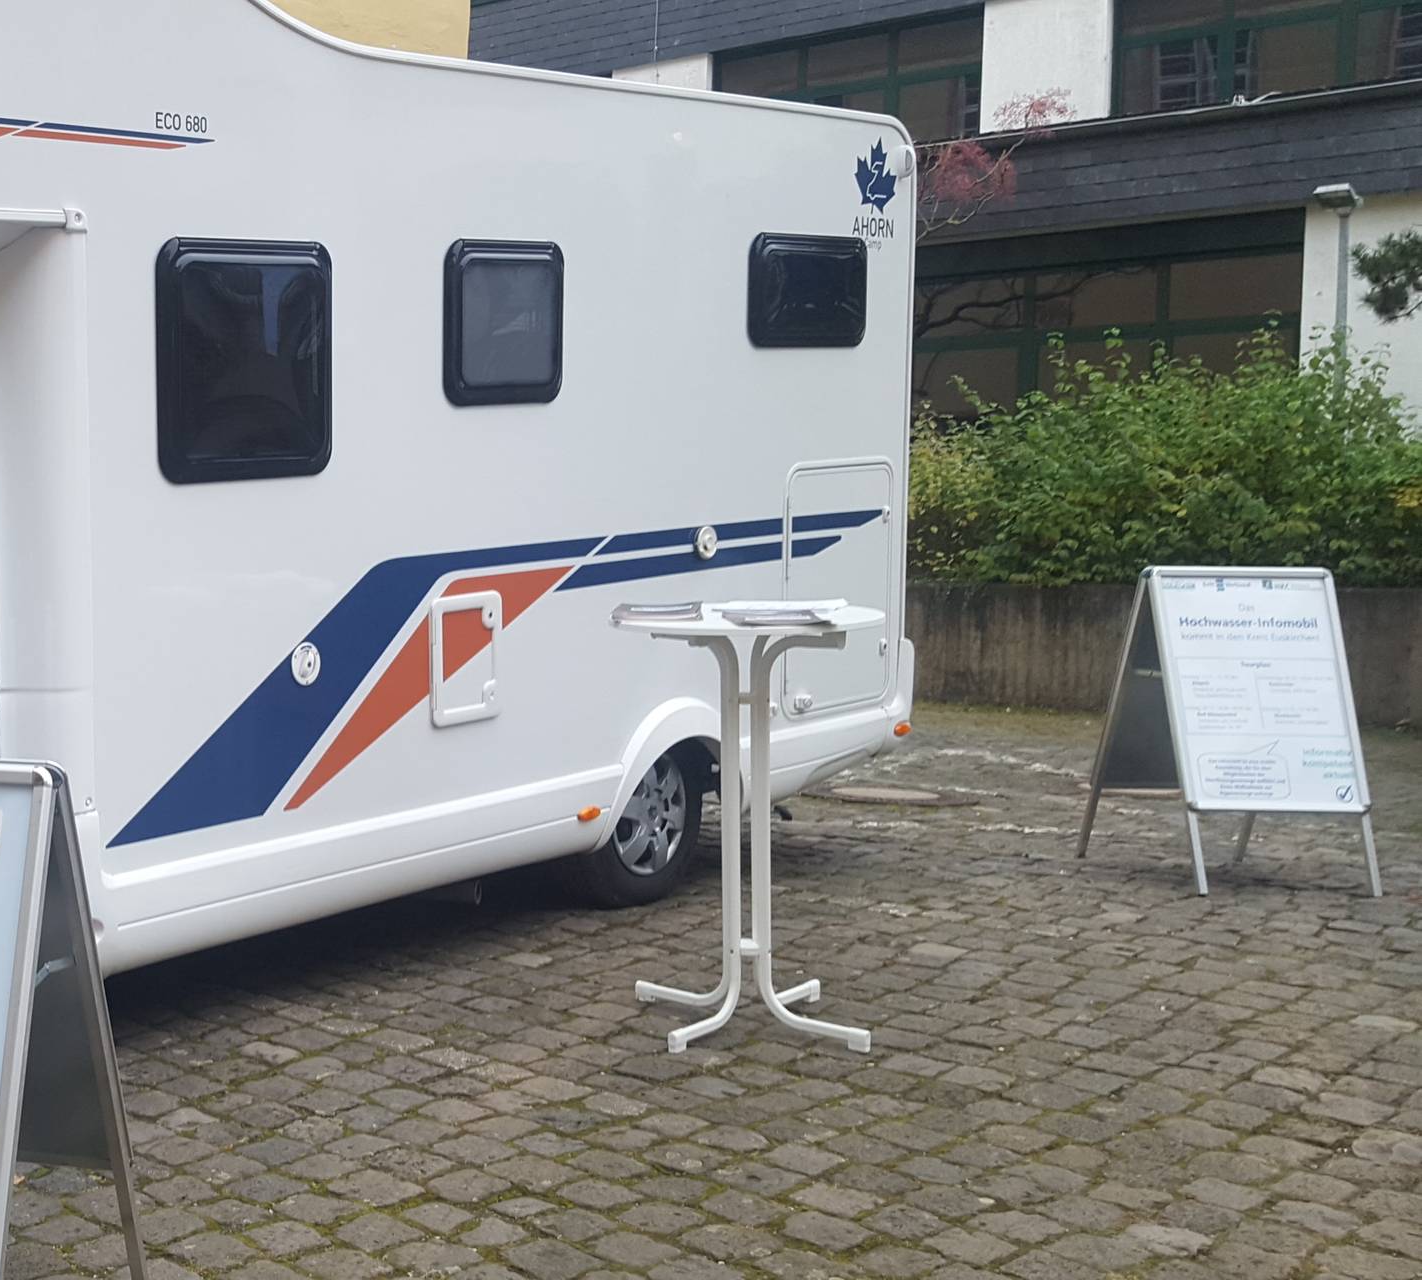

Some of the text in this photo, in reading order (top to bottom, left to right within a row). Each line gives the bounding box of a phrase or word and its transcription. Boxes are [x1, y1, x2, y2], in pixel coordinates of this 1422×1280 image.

[155, 111, 208, 133] ECO 680
[852, 216, 895, 238] AHORN
[1179, 615, 1319, 629] Hochwasser-Infomobil
